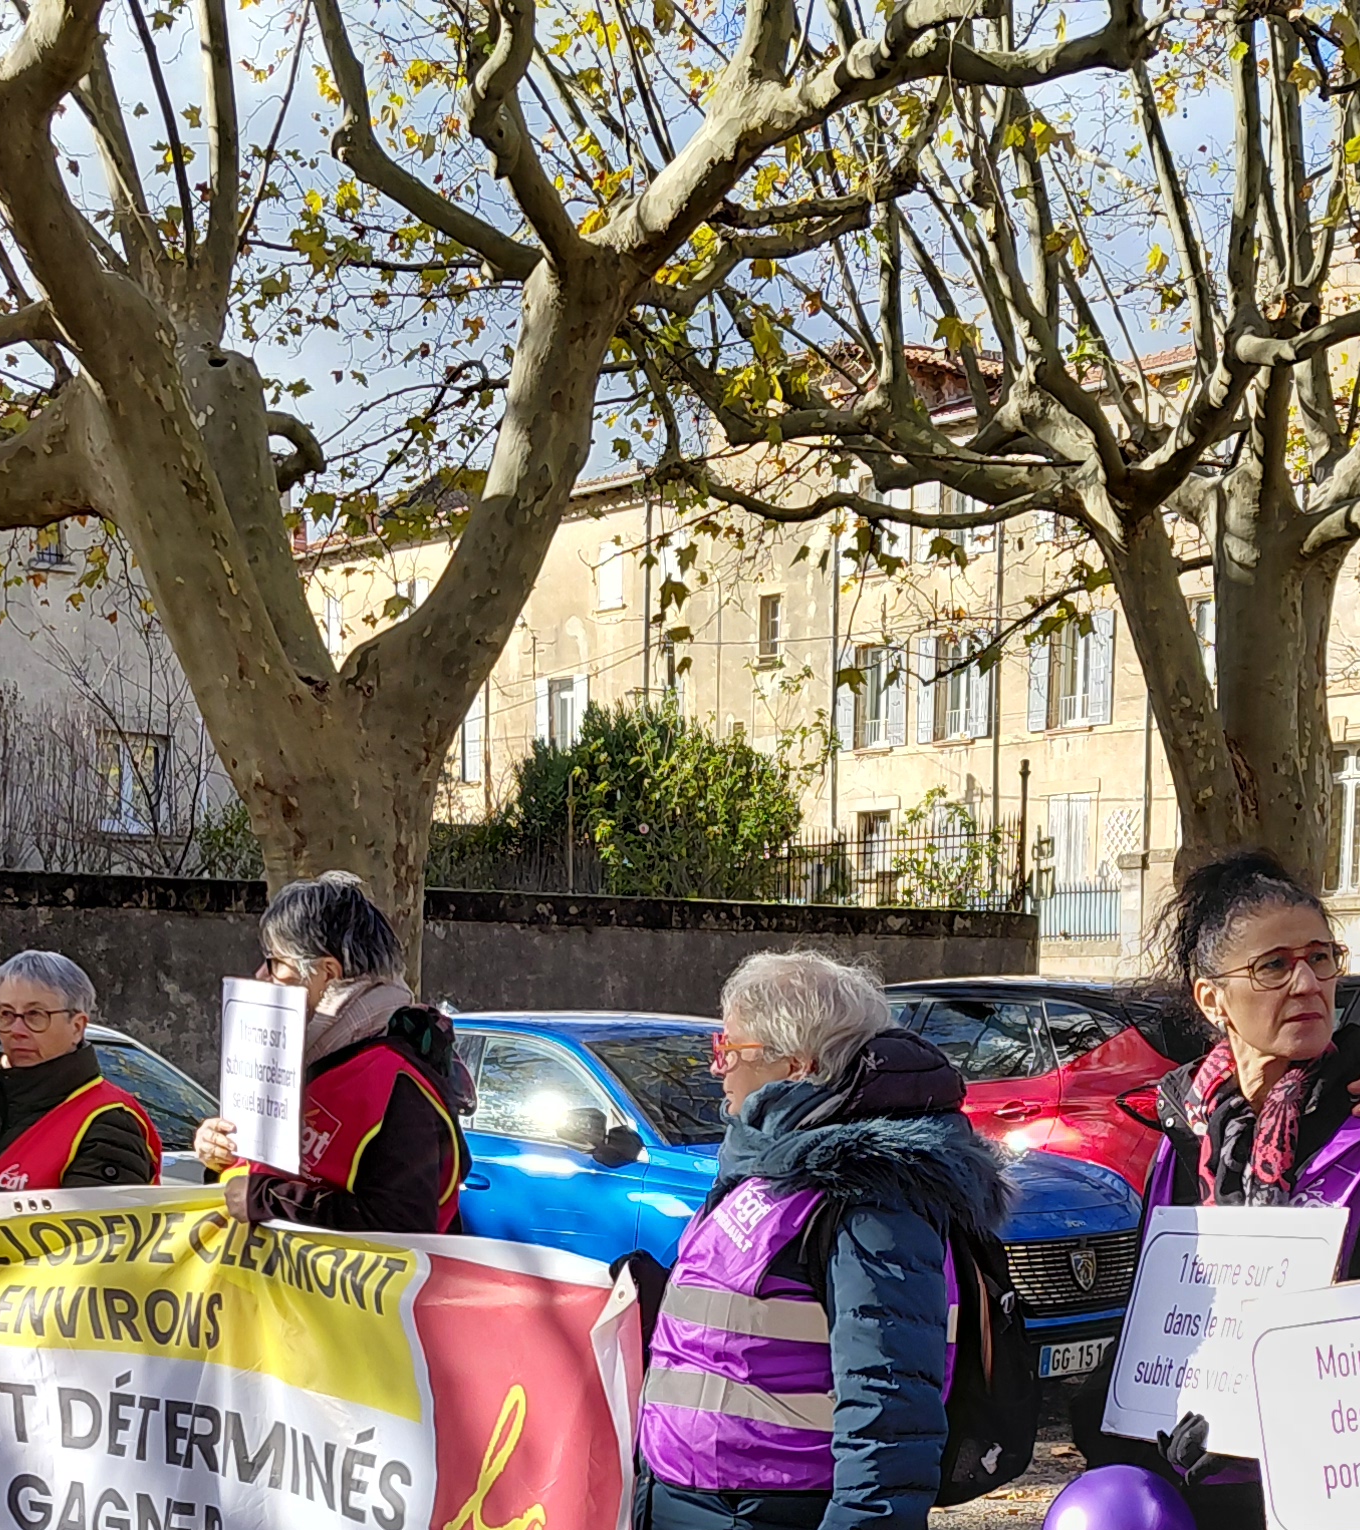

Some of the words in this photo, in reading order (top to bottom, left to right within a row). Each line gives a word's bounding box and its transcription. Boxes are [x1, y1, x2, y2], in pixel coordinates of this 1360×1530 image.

[269, 1030, 282, 1049] sur
[256, 1097, 265, 1116] au
[266, 1094, 288, 1121] travail
[301, 1126, 330, 1160] gt
[734, 1190, 771, 1227] cgt
[1179, 1253, 1190, 1284] 1
[1189, 1254, 1242, 1286] femme
[1244, 1263, 1274, 1288] sur
[1276, 1257, 1290, 1289] 3
[1163, 1304, 1202, 1338] dans
[1203, 1306, 1218, 1339] le
[1134, 1354, 1174, 1388] subit
[1175, 1358, 1201, 1390] des
